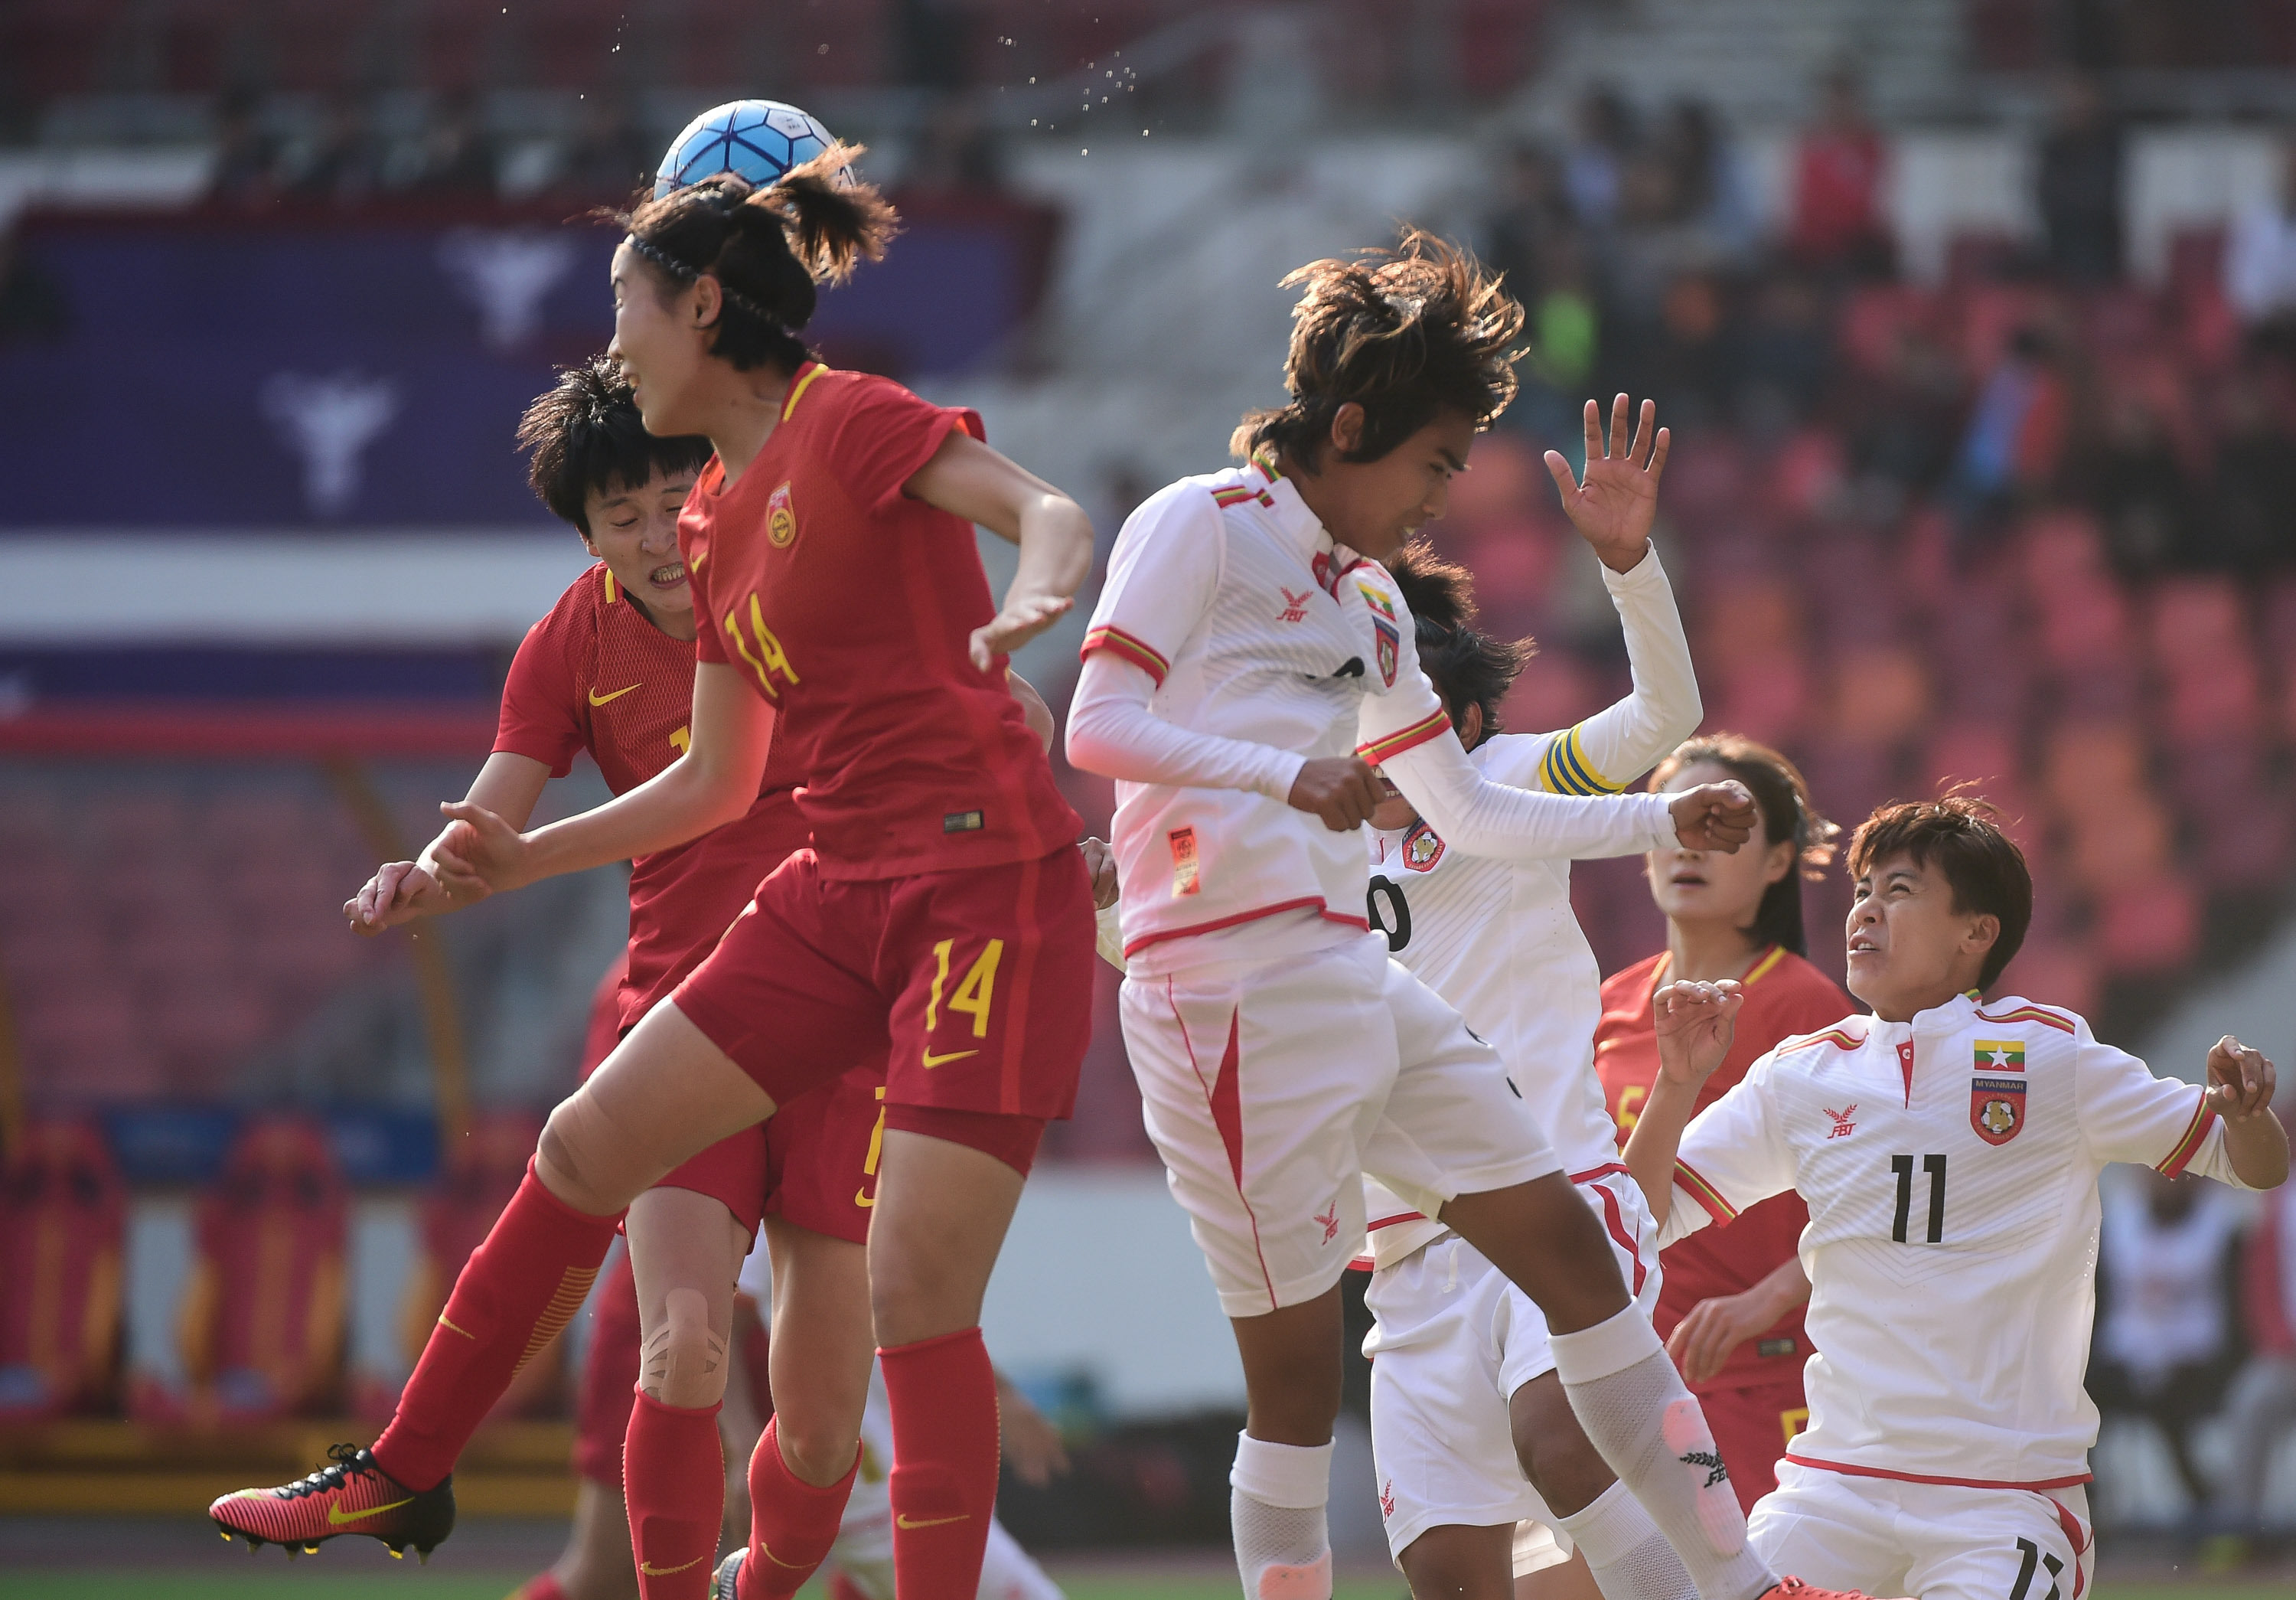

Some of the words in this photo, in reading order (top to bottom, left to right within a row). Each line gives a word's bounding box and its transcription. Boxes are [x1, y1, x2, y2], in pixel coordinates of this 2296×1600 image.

[725, 593, 800, 698] 14
[926, 938, 1004, 1038] 14
[1975, 1080, 2024, 1090] MYANMAR
[1827, 1123, 1857, 1139] FBT
[1891, 1154, 1947, 1243] 11
